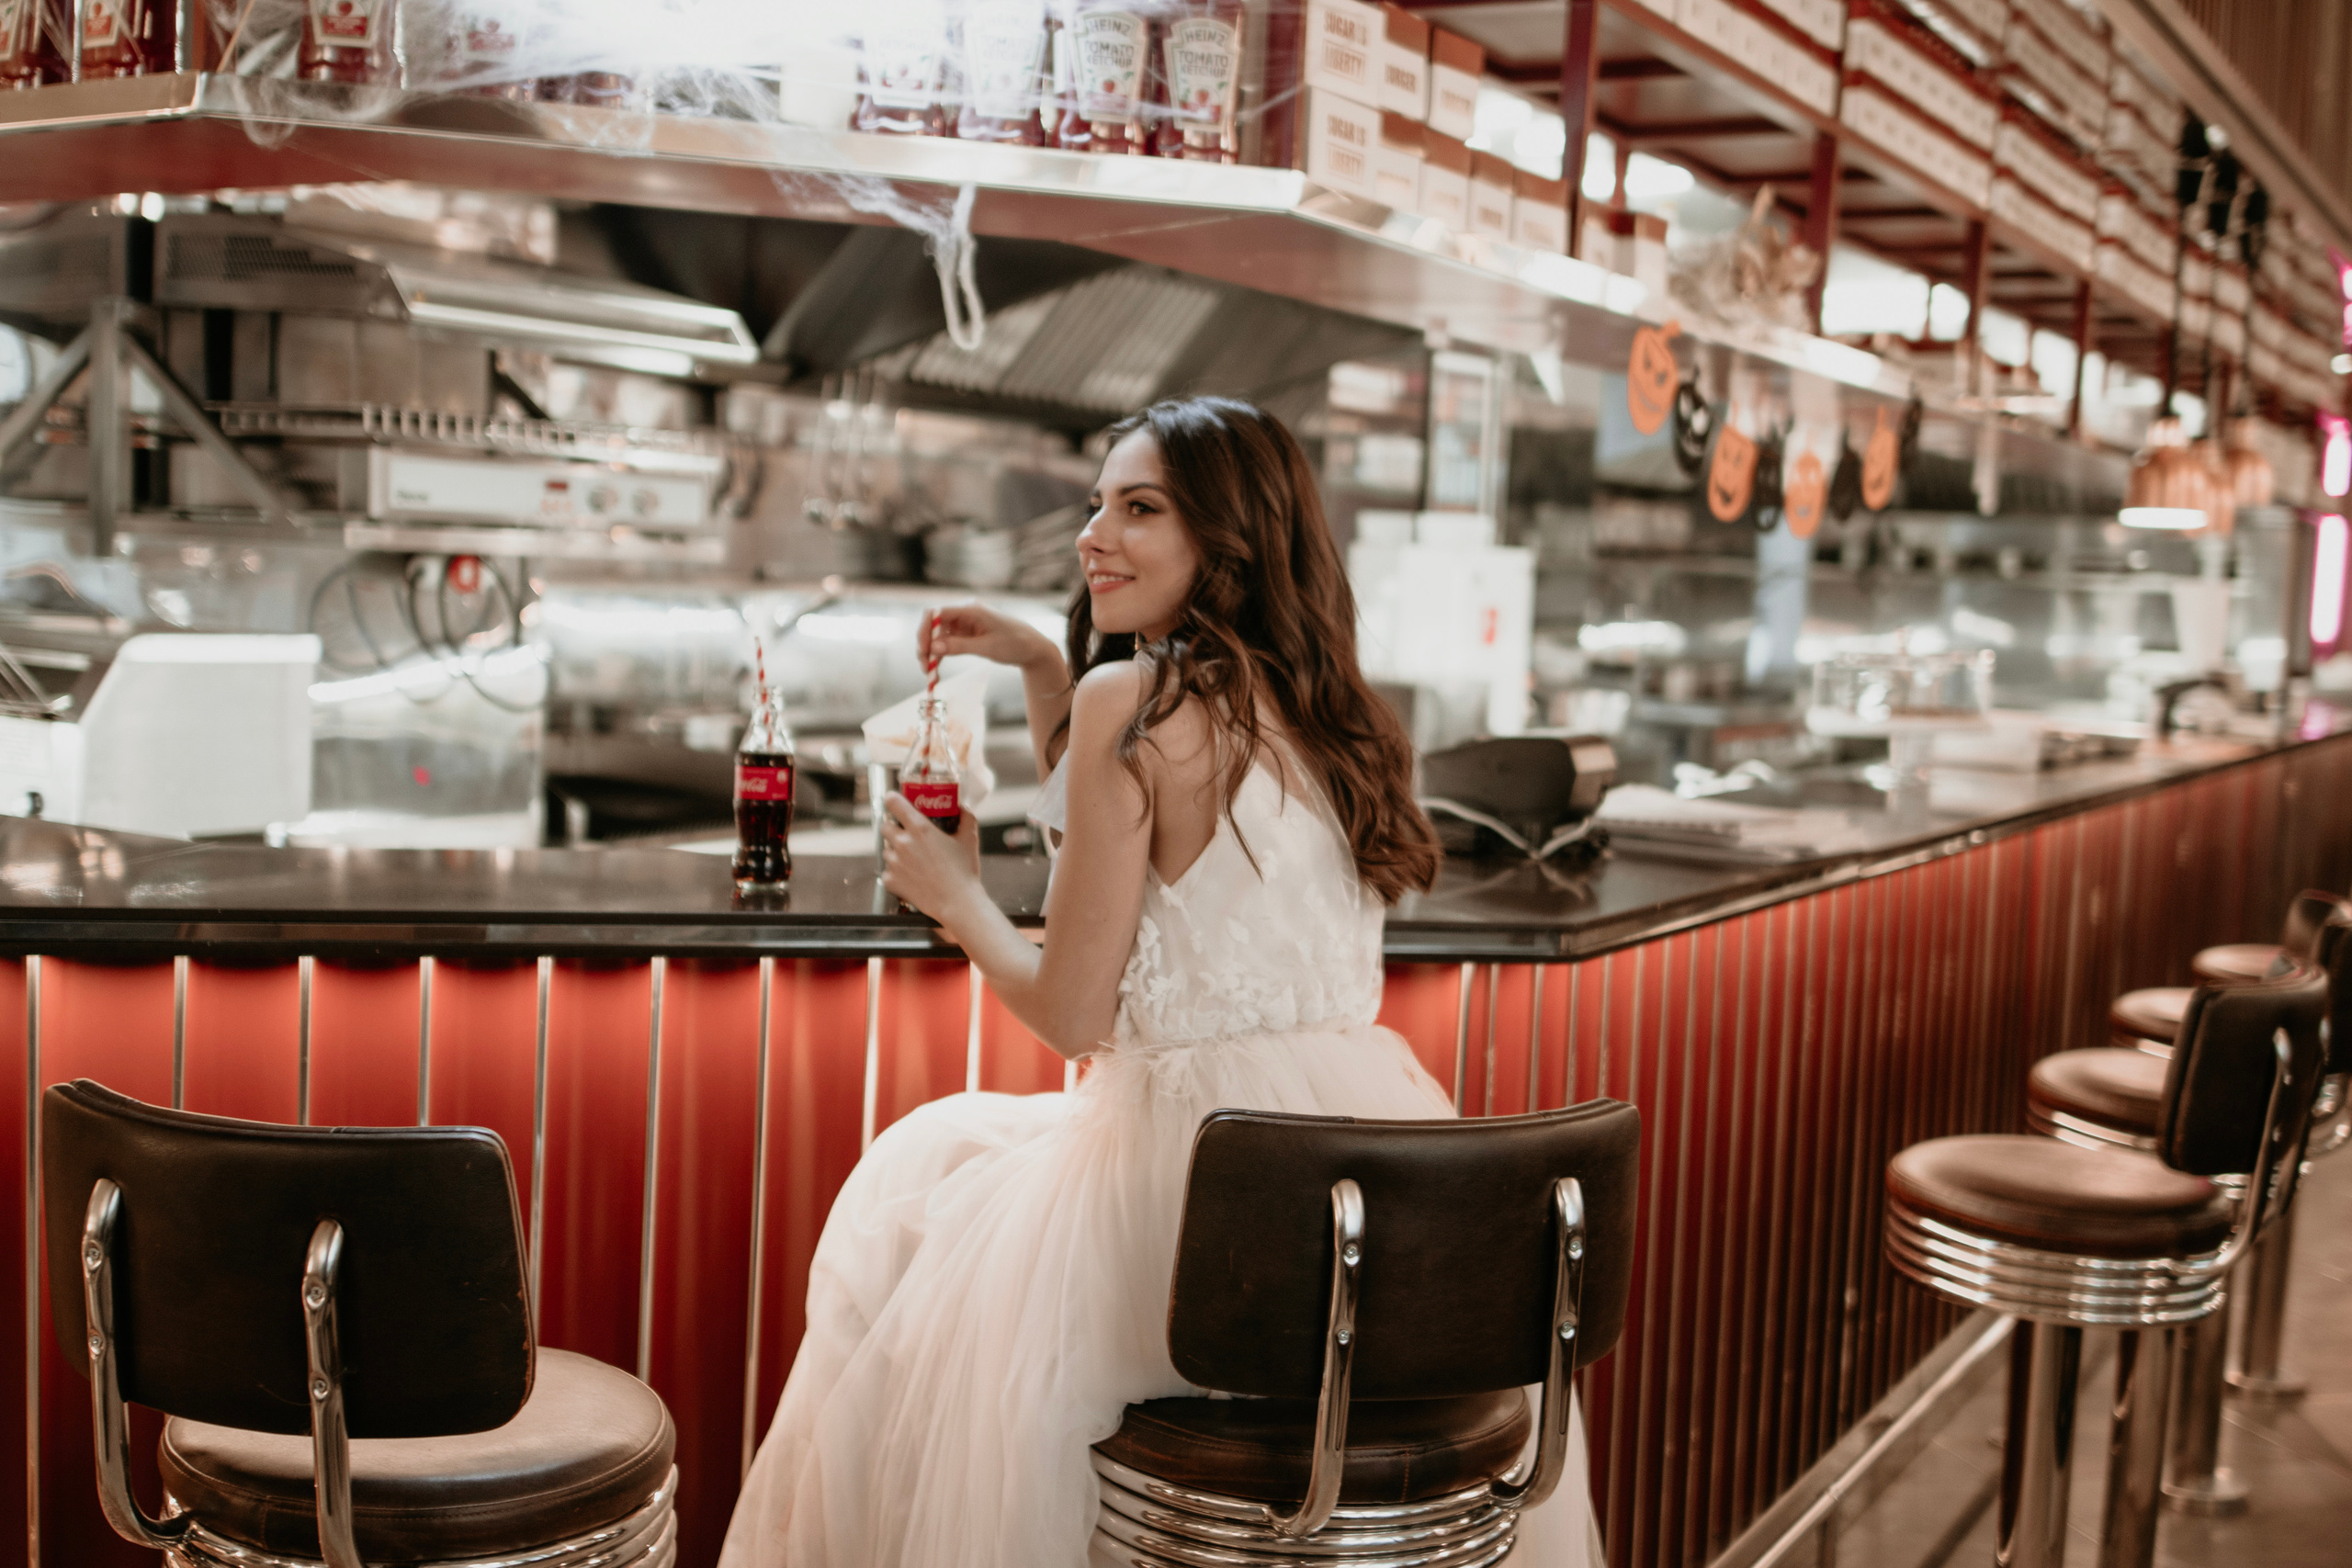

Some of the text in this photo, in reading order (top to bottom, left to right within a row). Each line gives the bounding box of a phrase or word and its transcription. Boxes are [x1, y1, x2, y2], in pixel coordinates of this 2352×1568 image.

[1089, 18, 1131, 36] HEINZ
[1323, 11, 1355, 42] SUGAR
[1184, 29, 1227, 47] HEINZ
[1085, 40, 1135, 58] TOMATO
[1086, 55, 1133, 69] KETCHUP
[1179, 51, 1229, 69] TOMATO
[1181, 63, 1227, 77] KETCHUP
[1326, 113, 1355, 144] SUGAR
